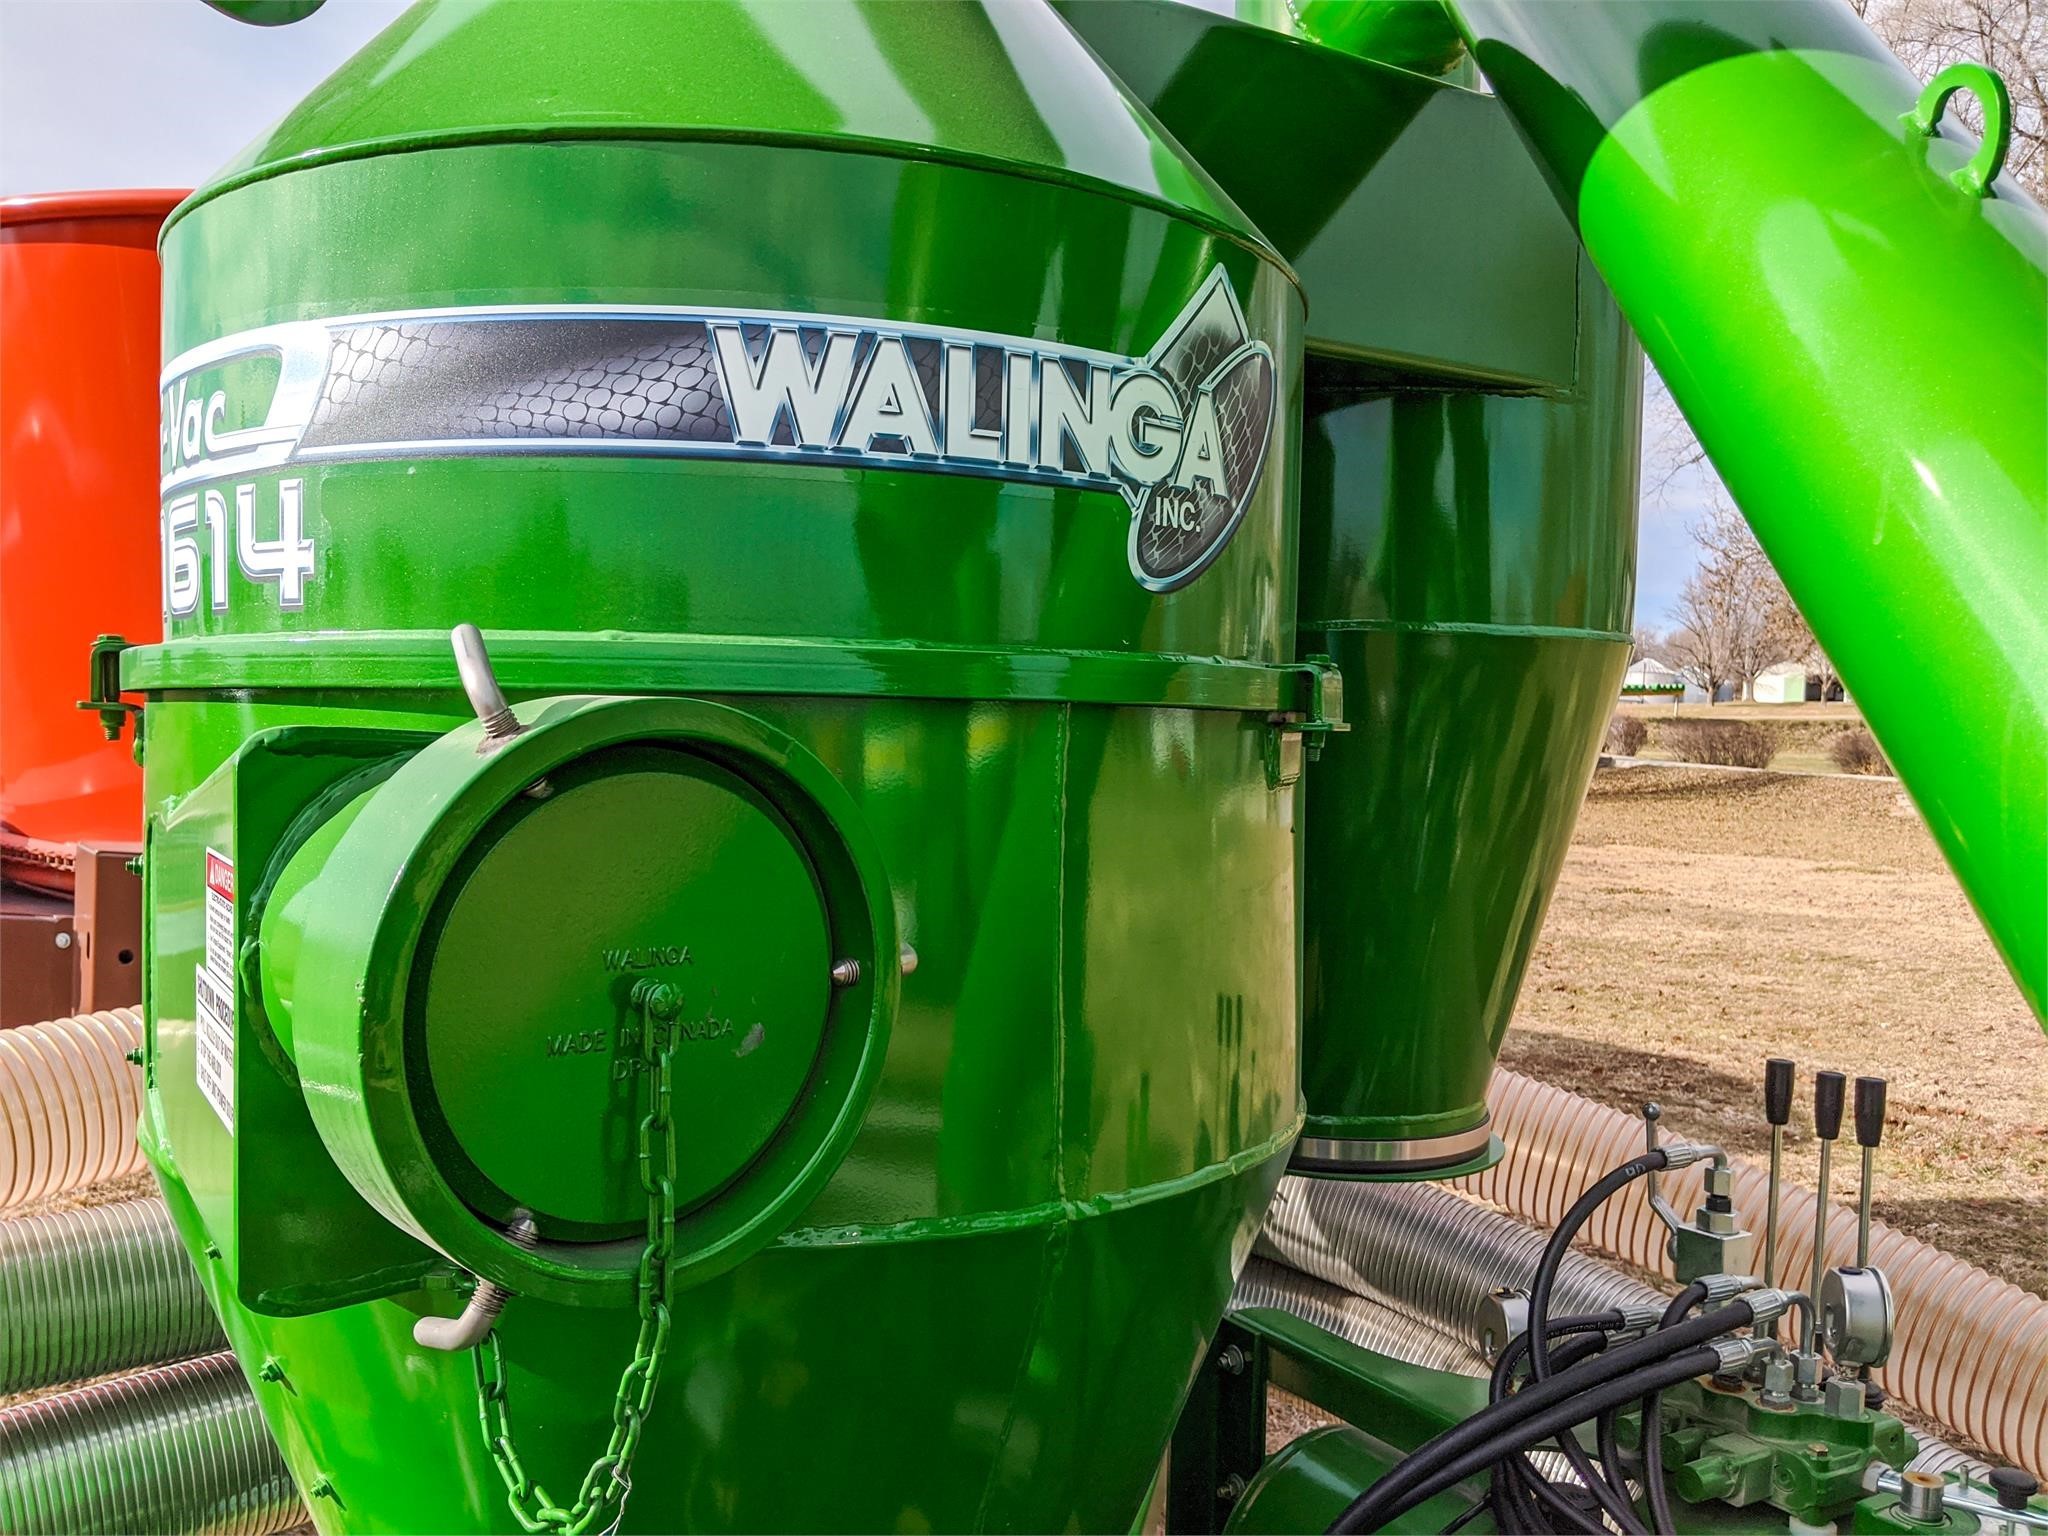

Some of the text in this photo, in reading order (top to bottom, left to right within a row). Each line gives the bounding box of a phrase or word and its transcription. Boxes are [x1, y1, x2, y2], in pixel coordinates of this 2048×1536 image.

[704, 319, 1229, 500] WALINGA
[1155, 496, 1200, 532] INC.
[602, 946, 694, 971] WALINGA
[547, 1018, 734, 1057] MADE IN CNADA
